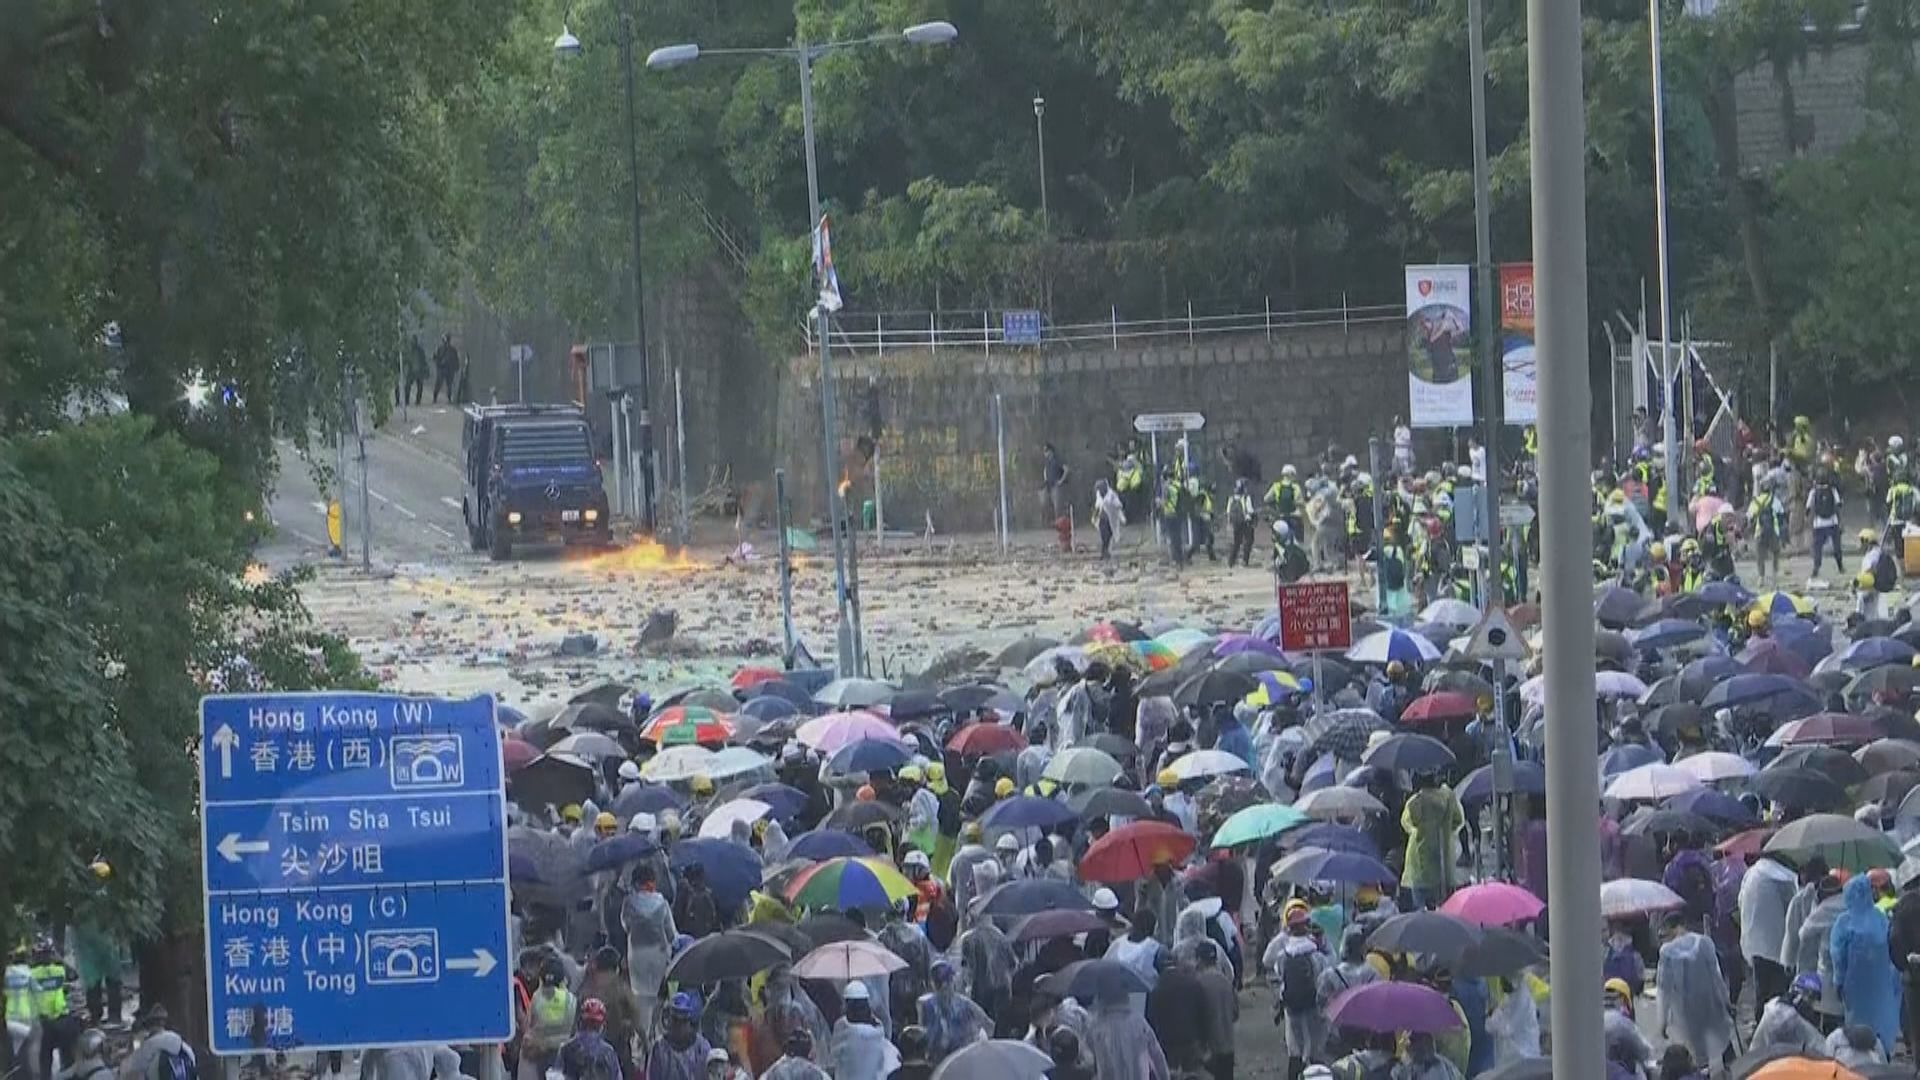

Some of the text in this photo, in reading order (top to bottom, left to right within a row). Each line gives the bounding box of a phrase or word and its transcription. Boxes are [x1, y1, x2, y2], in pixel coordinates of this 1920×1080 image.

[249, 703, 433, 731] Hong Kong (W)
[249, 737, 388, 773] 香港(西)
[443, 764, 459, 780] W
[280, 806, 451, 833] Tsim Sha Tsui
[280, 843, 383, 876] 尖沙咀
[222, 895, 408, 927] Hong Kong (C)
[223, 932, 362, 969] 香港(中)
[421, 956, 433, 974] C
[225, 969, 356, 995] Kwun Tong
